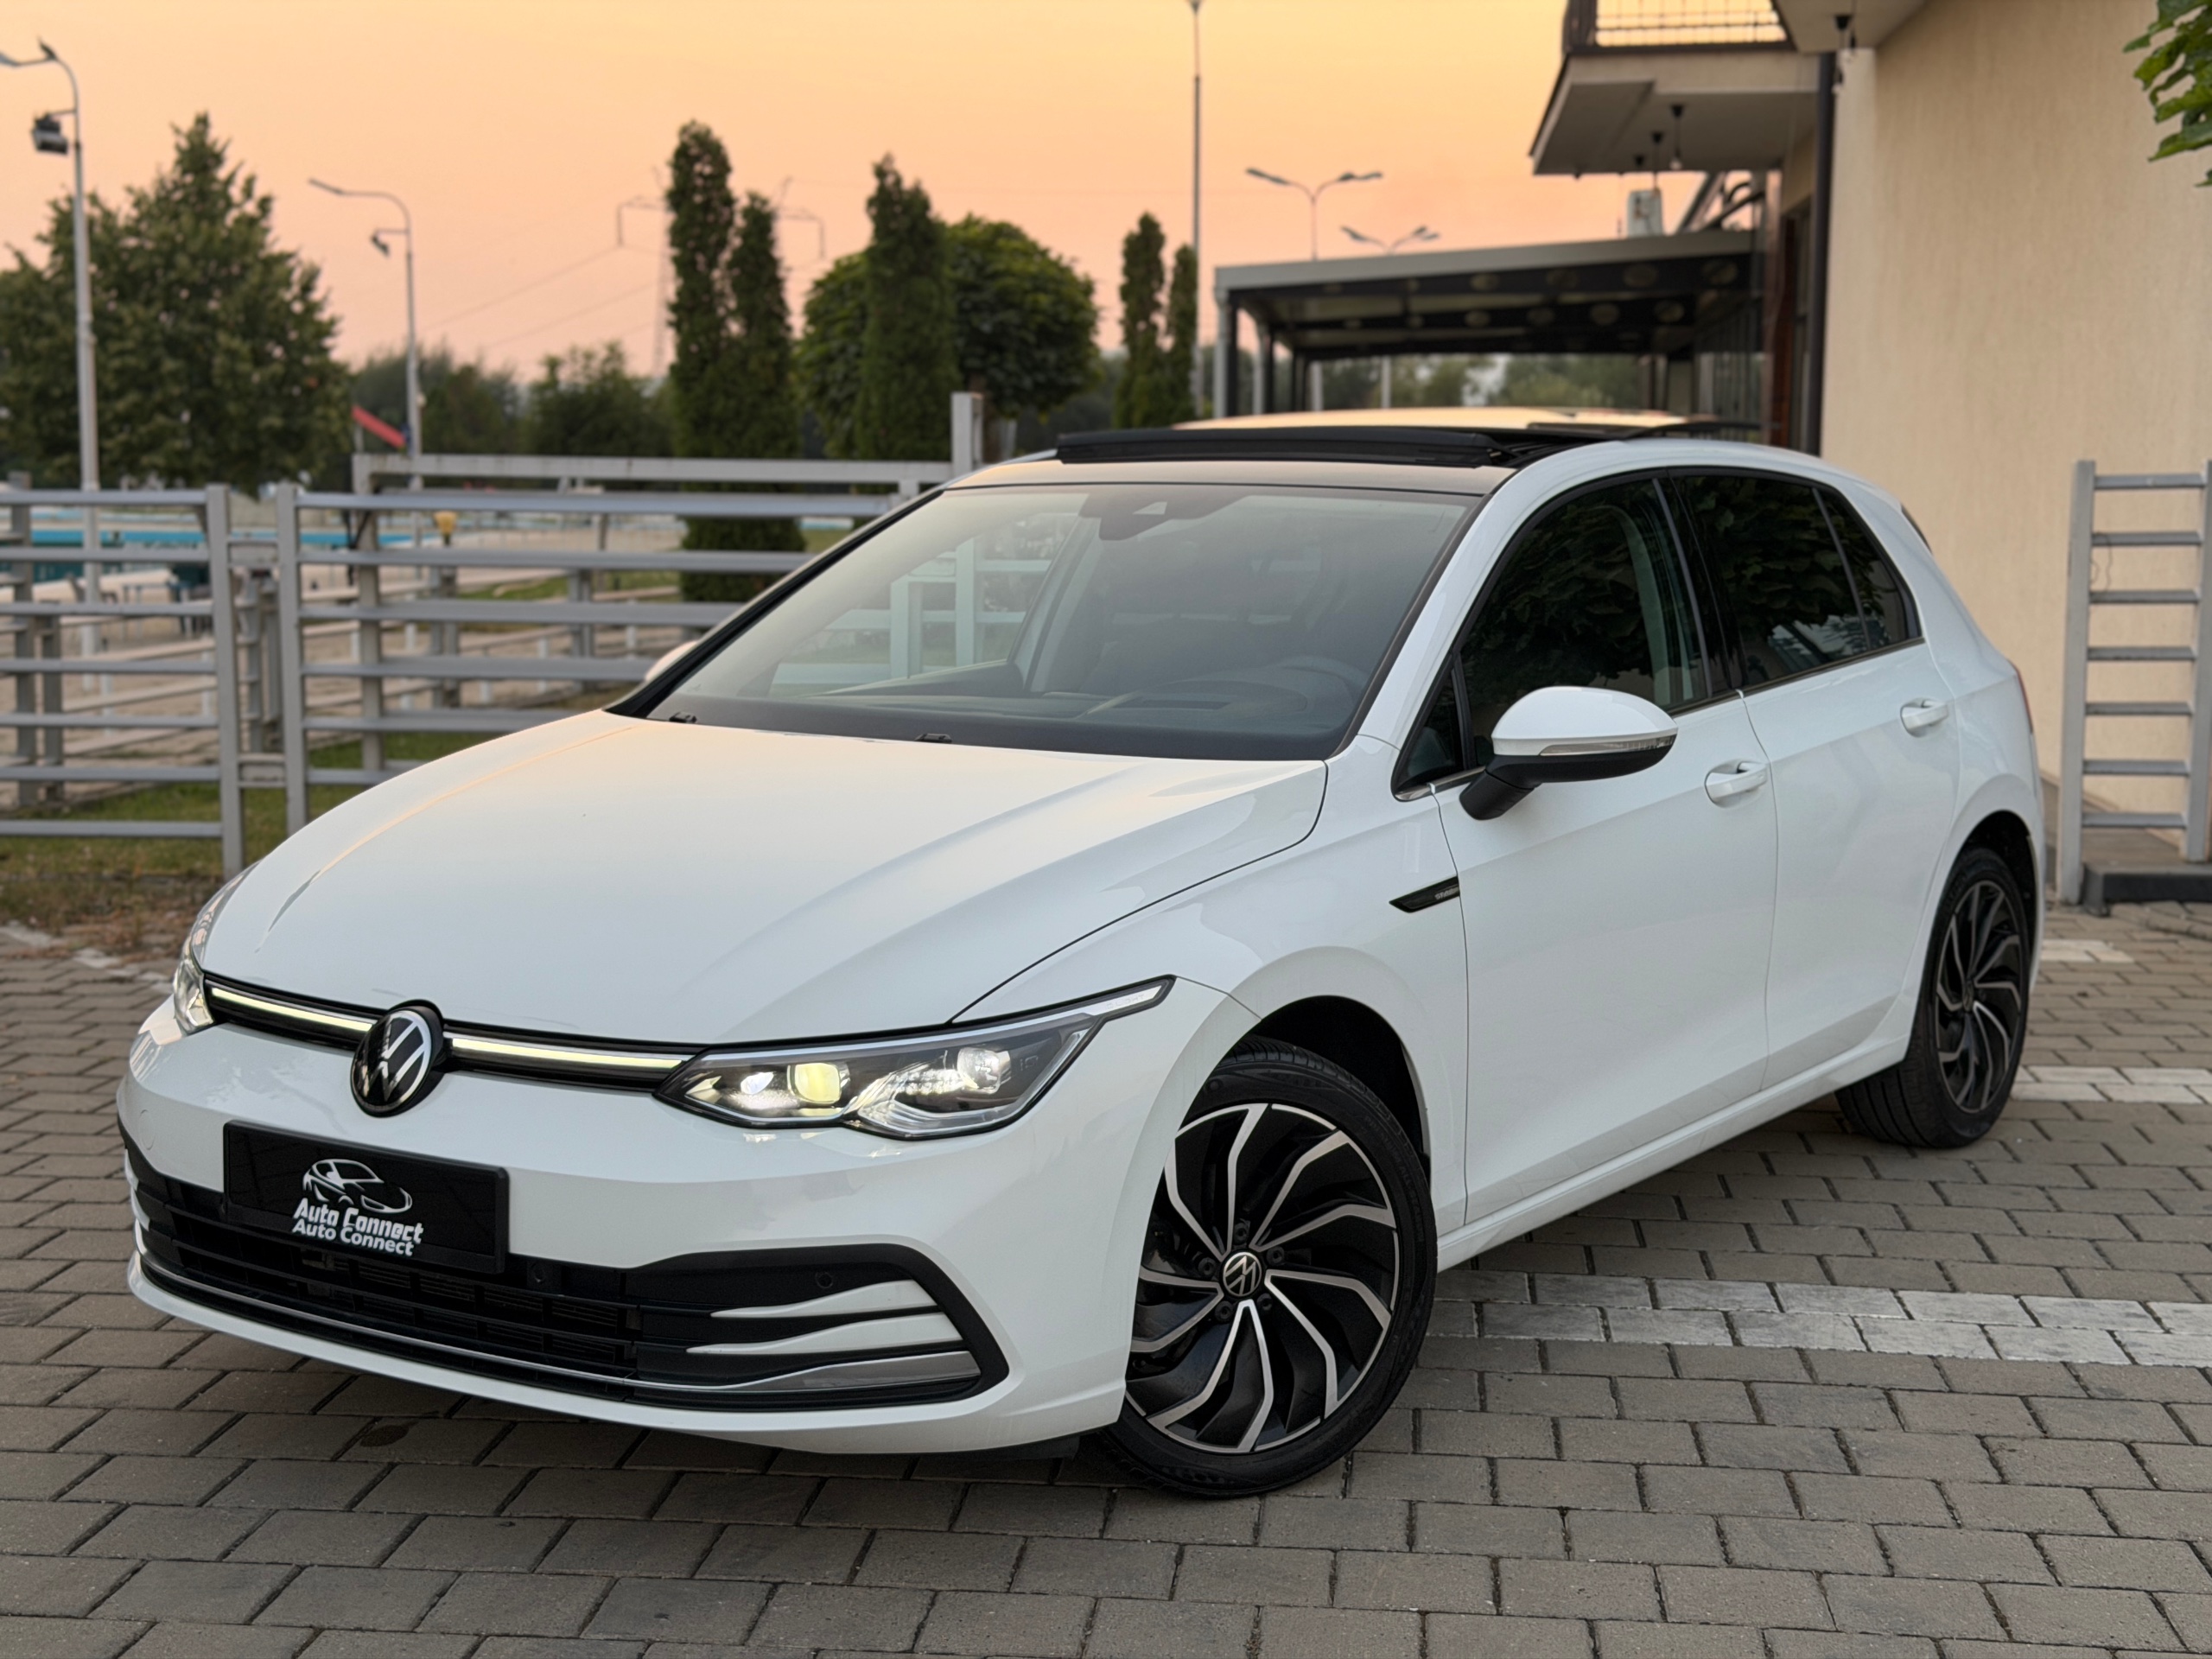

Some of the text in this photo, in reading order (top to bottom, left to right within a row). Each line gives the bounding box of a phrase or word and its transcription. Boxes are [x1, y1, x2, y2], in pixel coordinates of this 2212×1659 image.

[292, 1218, 415, 1256] Auto Connect
[293, 1198, 424, 1244] Auto Connect
